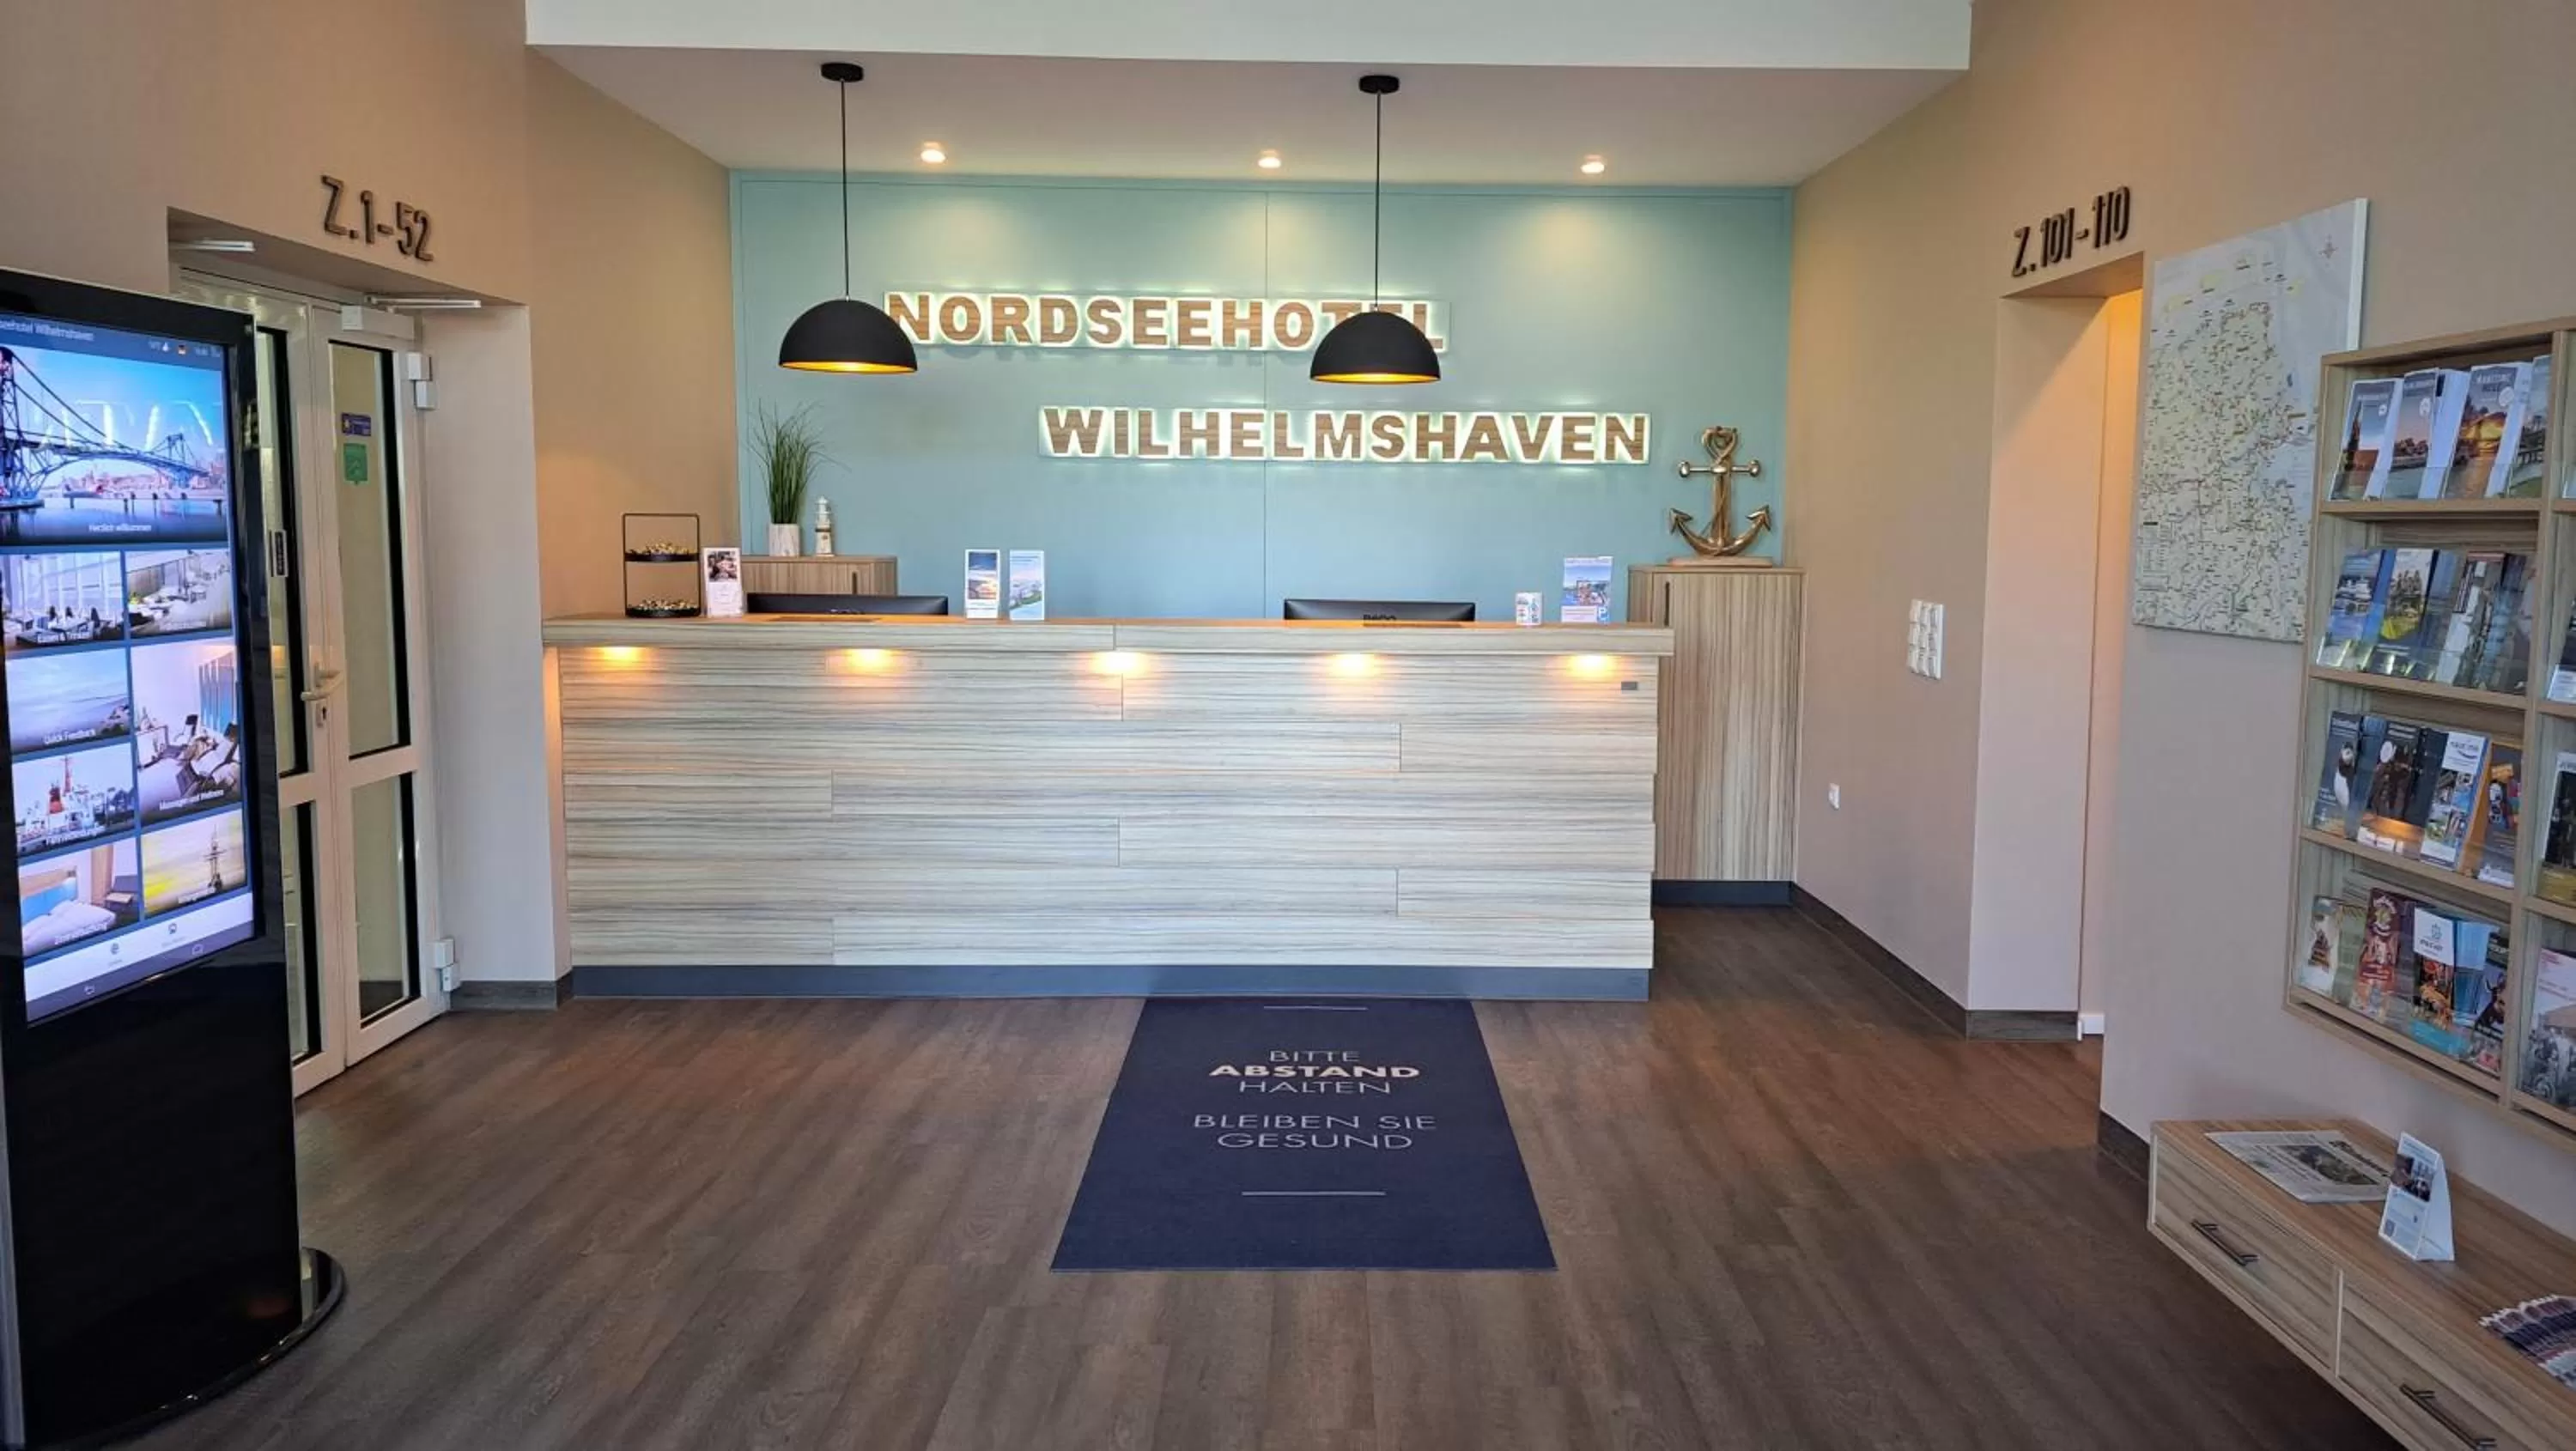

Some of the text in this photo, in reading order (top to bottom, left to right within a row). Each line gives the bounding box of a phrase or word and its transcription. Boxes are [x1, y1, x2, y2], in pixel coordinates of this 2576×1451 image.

[321, 175, 434, 262] Z.1-52
[2012, 186, 2130, 277] Z.101-110
[886, 293, 1444, 350] NORDSEEHOTL
[1042, 406, 1647, 463] WILHELMSHAVEN
[1269, 1049, 1361, 1063] BITTE
[1208, 1065, 1421, 1078] ABSTAND
[1238, 1080, 1391, 1094] HALTEN
[1194, 1114, 1439, 1130] BLEIBEN SIE
[1217, 1132, 1413, 1150] GESUND
